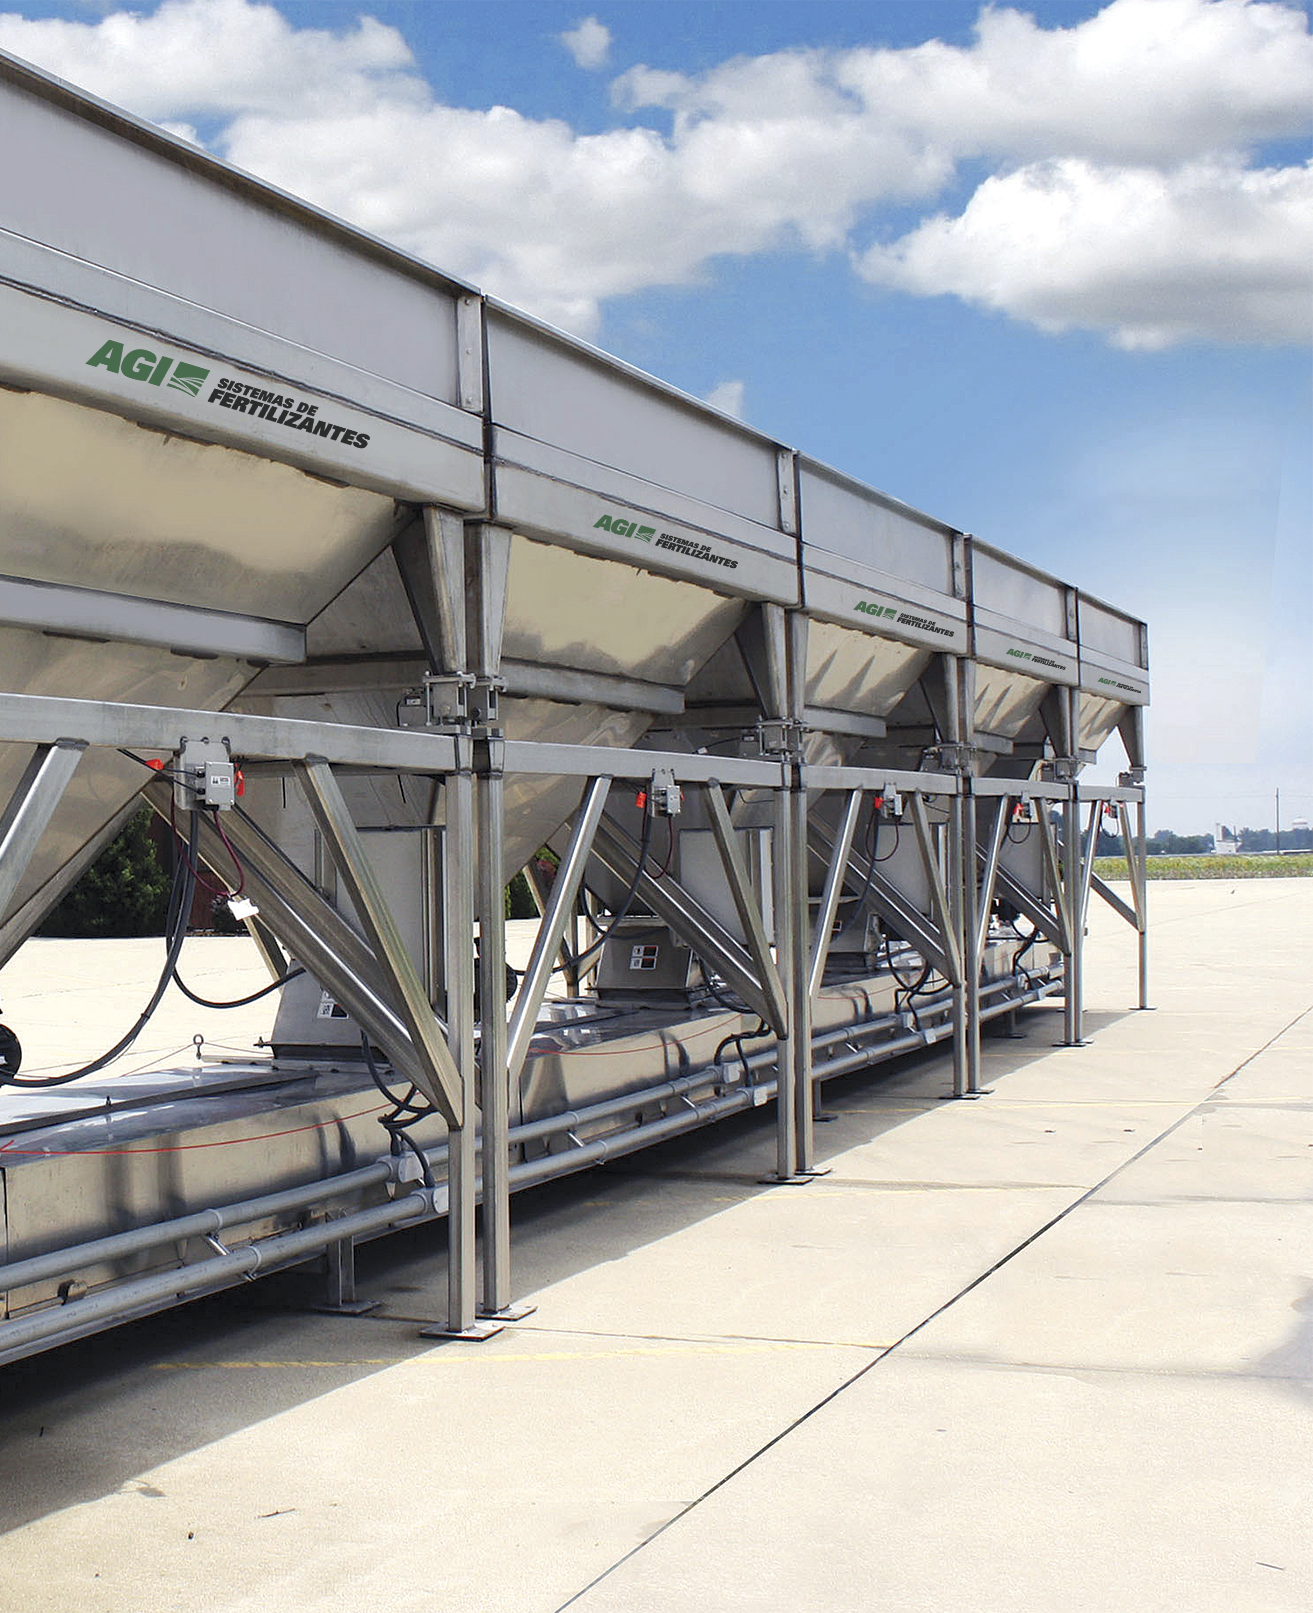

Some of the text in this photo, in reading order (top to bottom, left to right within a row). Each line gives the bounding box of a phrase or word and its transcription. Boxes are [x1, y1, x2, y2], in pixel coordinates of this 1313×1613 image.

[86, 340, 174, 386] AGI
[218, 378, 318, 416] SISTEMAS DE
[208, 389, 370, 448] FERTILIZANTES
[593, 514, 637, 538] AGI
[660, 533, 699, 548] SISTEMAS
[655, 539, 738, 568] FERTILIZANTES
[853, 601, 884, 617] AGI
[897, 617, 954, 637] FERTILIZANTES
[1006, 648, 1024, 658] AGI
